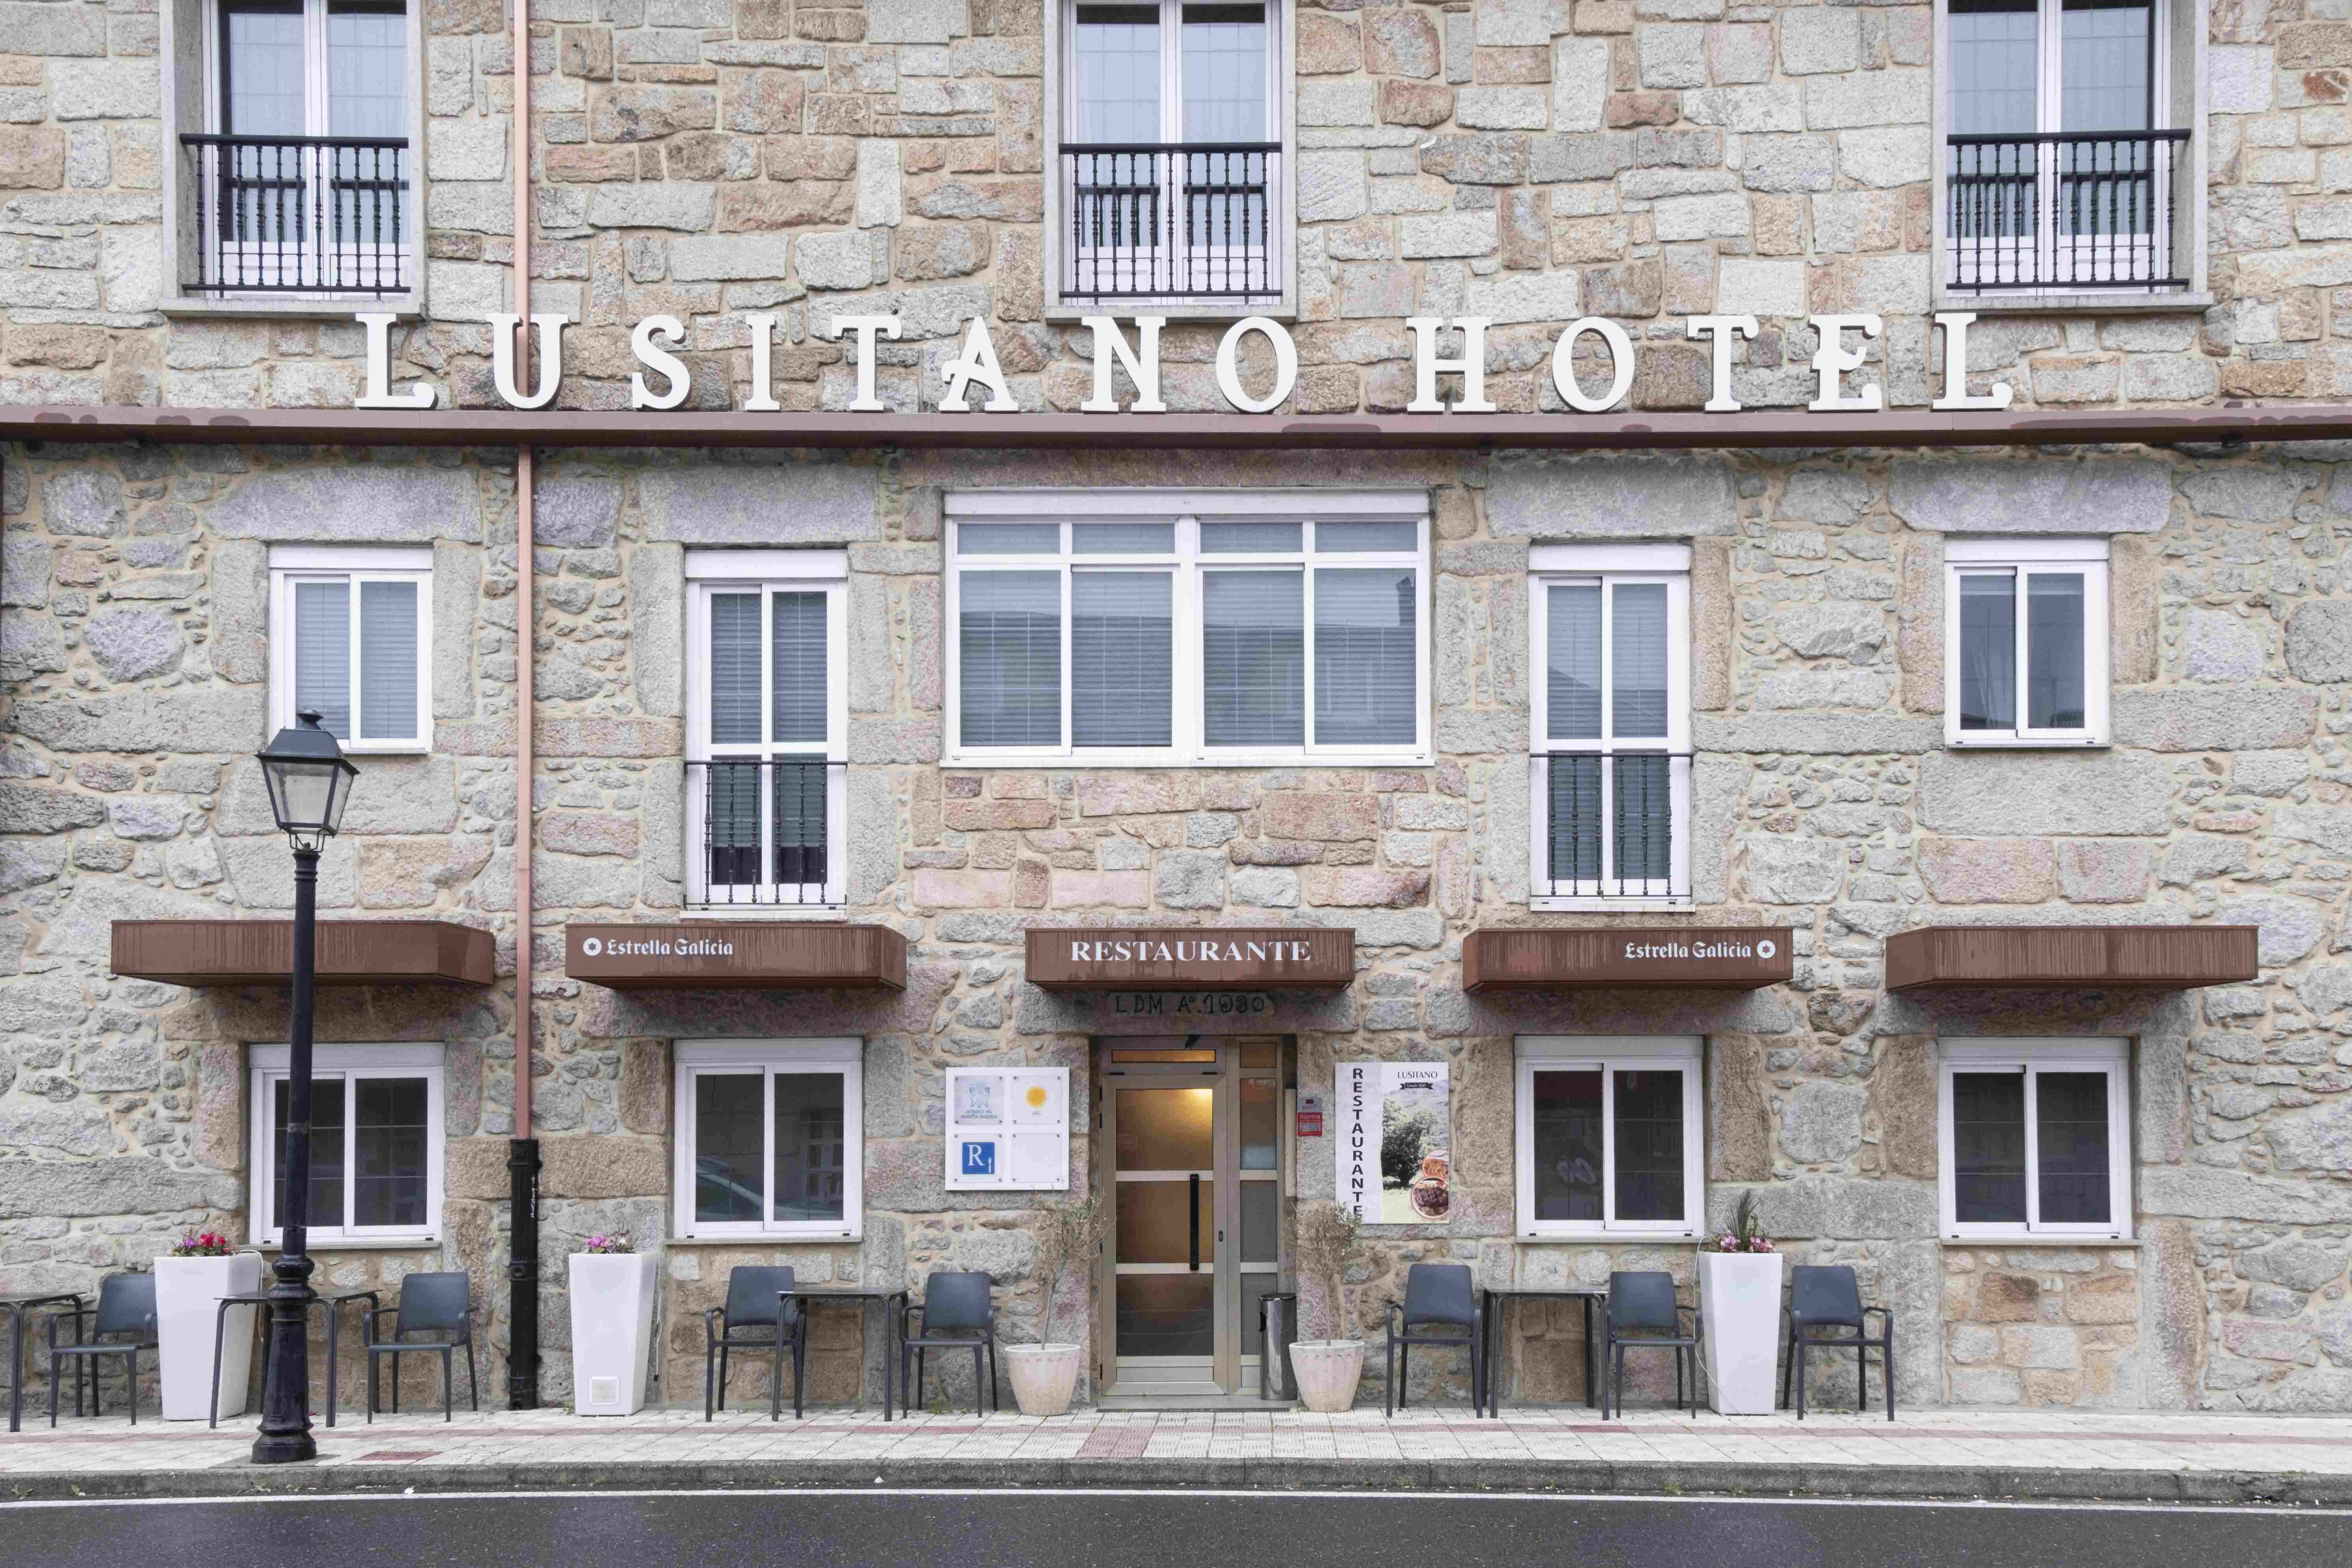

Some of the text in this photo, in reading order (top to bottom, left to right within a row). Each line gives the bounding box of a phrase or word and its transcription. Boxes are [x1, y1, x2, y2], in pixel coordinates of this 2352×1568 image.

[354, 312, 2013, 412] LUSITANO HOTEL
[606, 938, 733, 955] Estrella Galicia
[1071, 941, 1310, 961] RESTAURANTE
[1624, 941, 1752, 959] Estrella Galicia
[1352, 1068, 1364, 1217] RESTAURANTE
[967, 1144, 986, 1166] R
